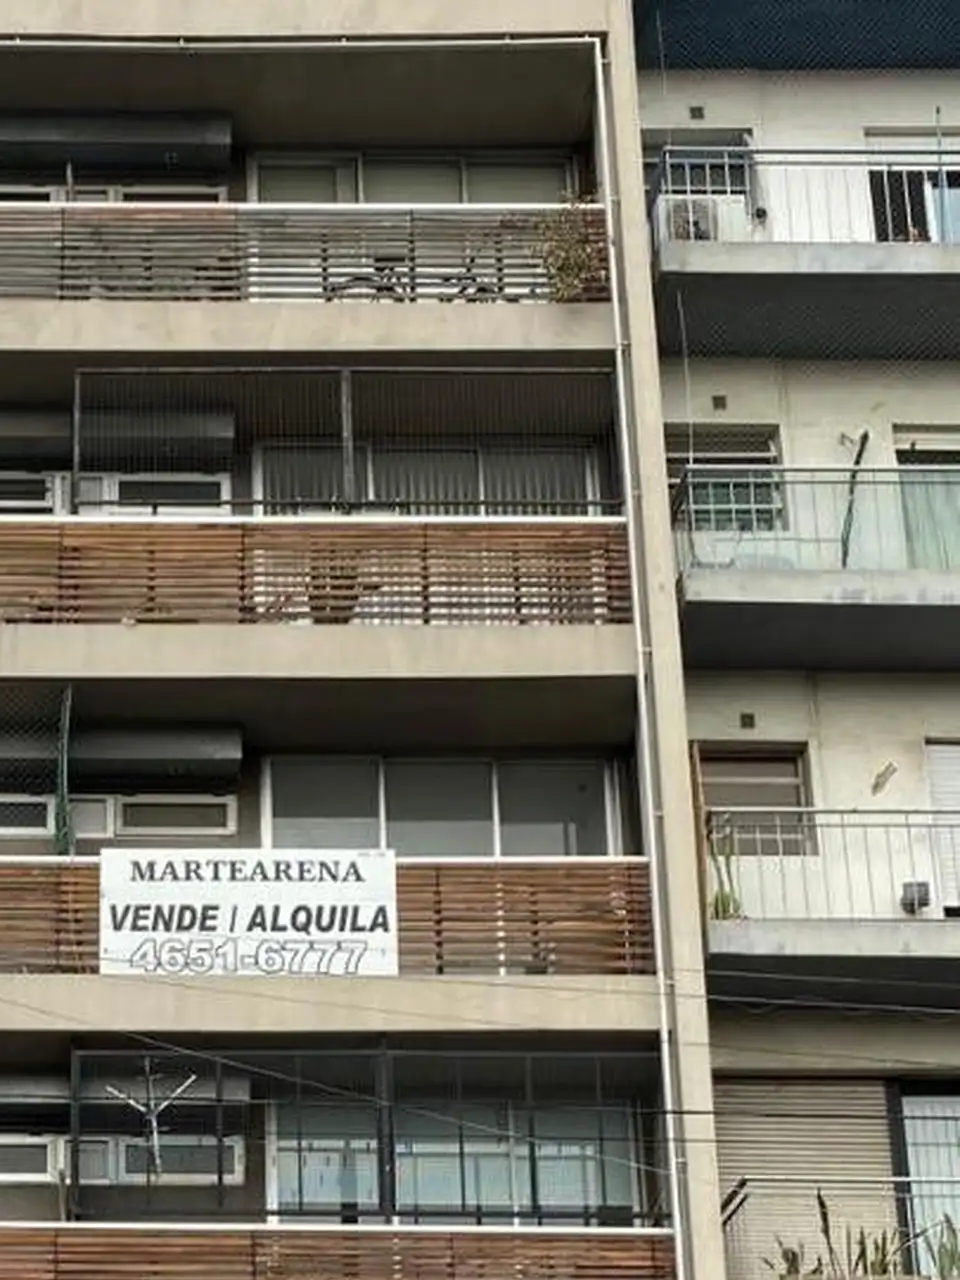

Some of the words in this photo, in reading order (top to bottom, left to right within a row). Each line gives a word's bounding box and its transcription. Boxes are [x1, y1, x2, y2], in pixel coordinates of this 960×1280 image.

[130, 859, 366, 883] MARTEARENA
[109, 904, 220, 932] VENDE
[246, 905, 390, 934] ALQUILA
[130, 937, 368, 975] 4651-6777
